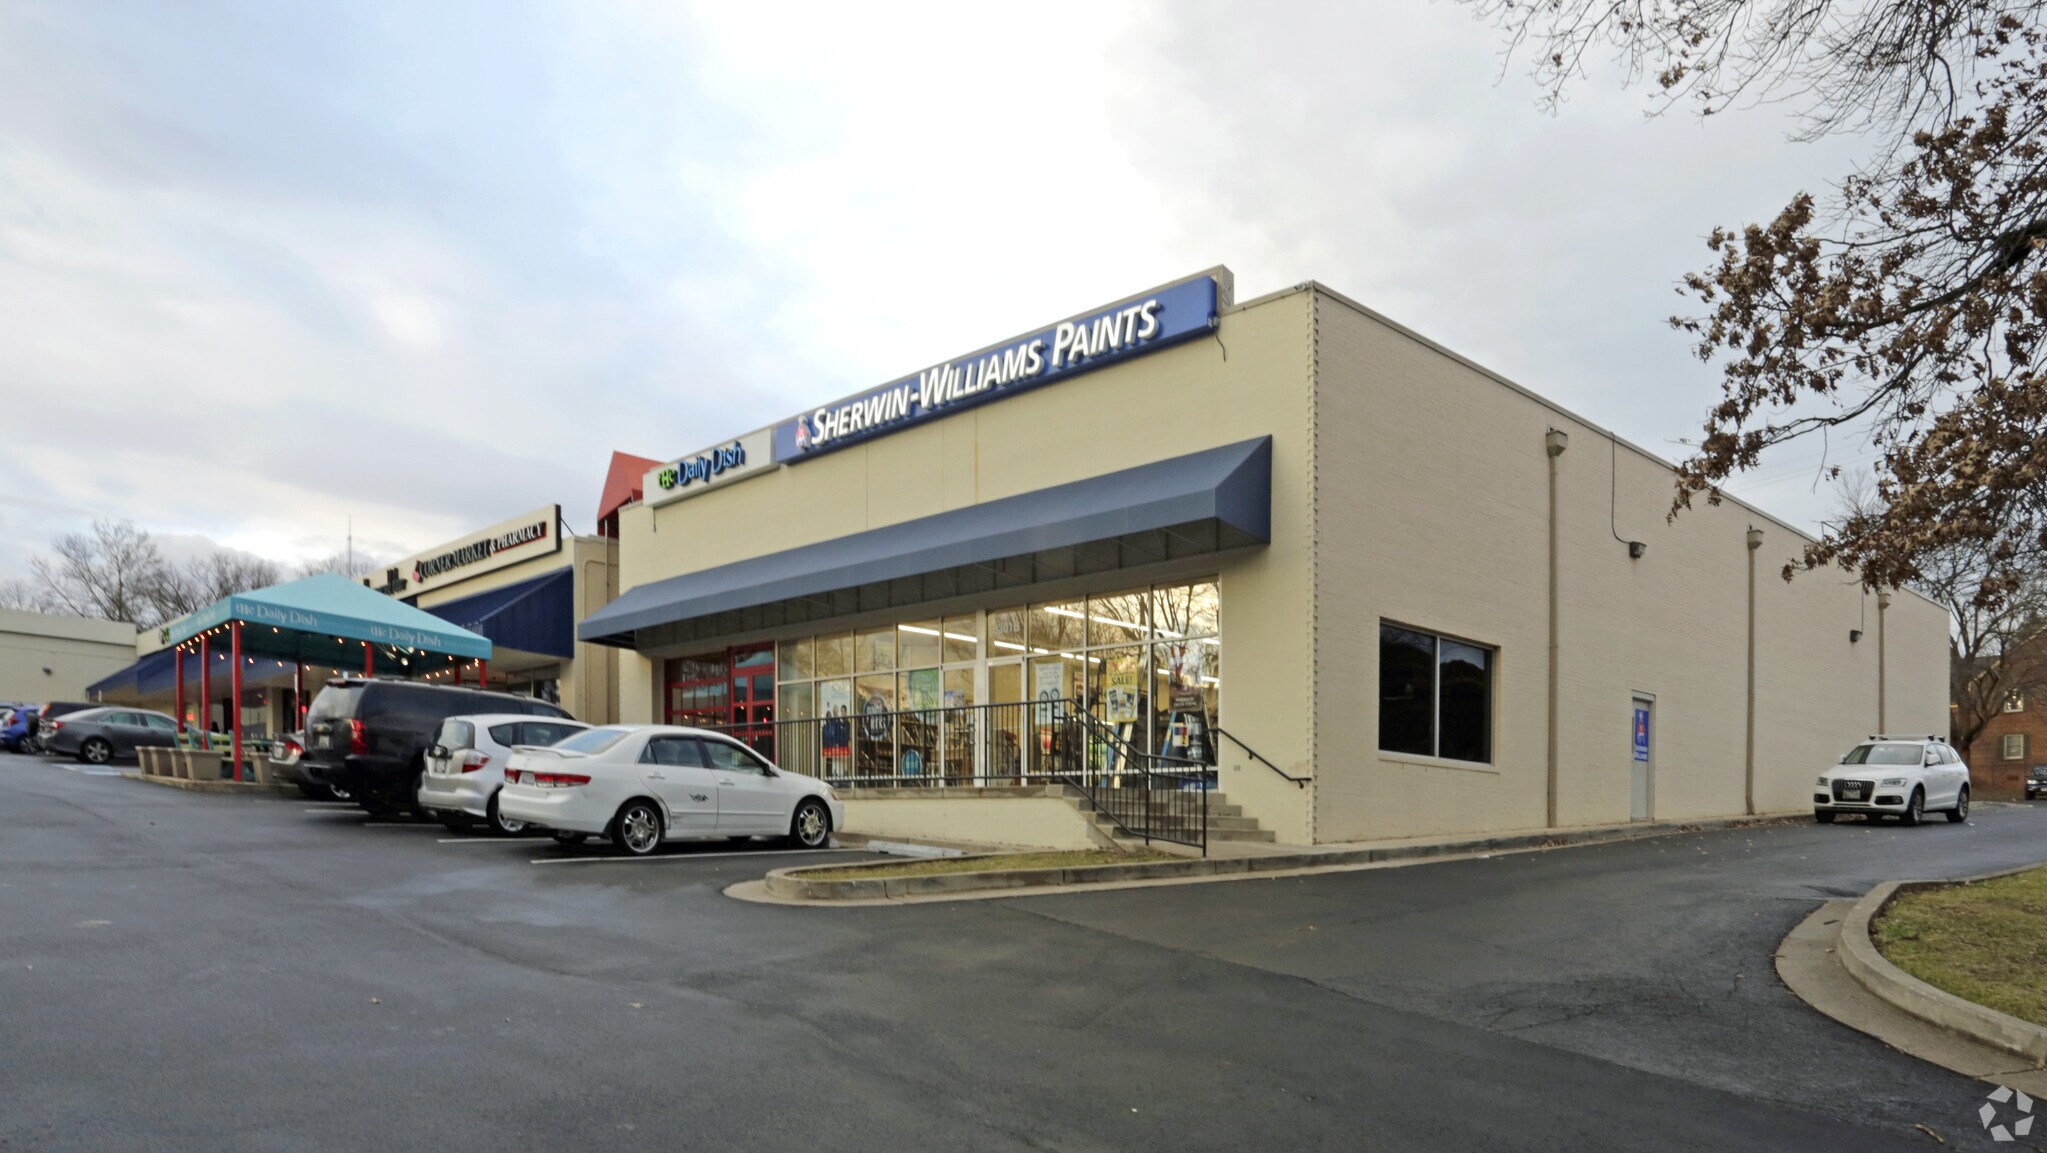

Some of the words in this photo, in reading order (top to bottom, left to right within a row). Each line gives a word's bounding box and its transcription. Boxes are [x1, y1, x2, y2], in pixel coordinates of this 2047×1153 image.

[811, 338, 1046, 446] SHERWIN-WILLIAMS
[1052, 299, 1165, 369] PAINTS
[677, 457, 712, 487] Daily
[711, 440, 746, 475] Dish
[419, 553, 453, 578] CORNER
[452, 538, 490, 569] MARKET
[496, 521, 546, 551] PHARMACY
[256, 604, 288, 624] Daily
[289, 609, 318, 628] Dish
[388, 627, 416, 645] Daily
[417, 631, 441, 648] Dish
[1111, 675, 1132, 686] SALE!
